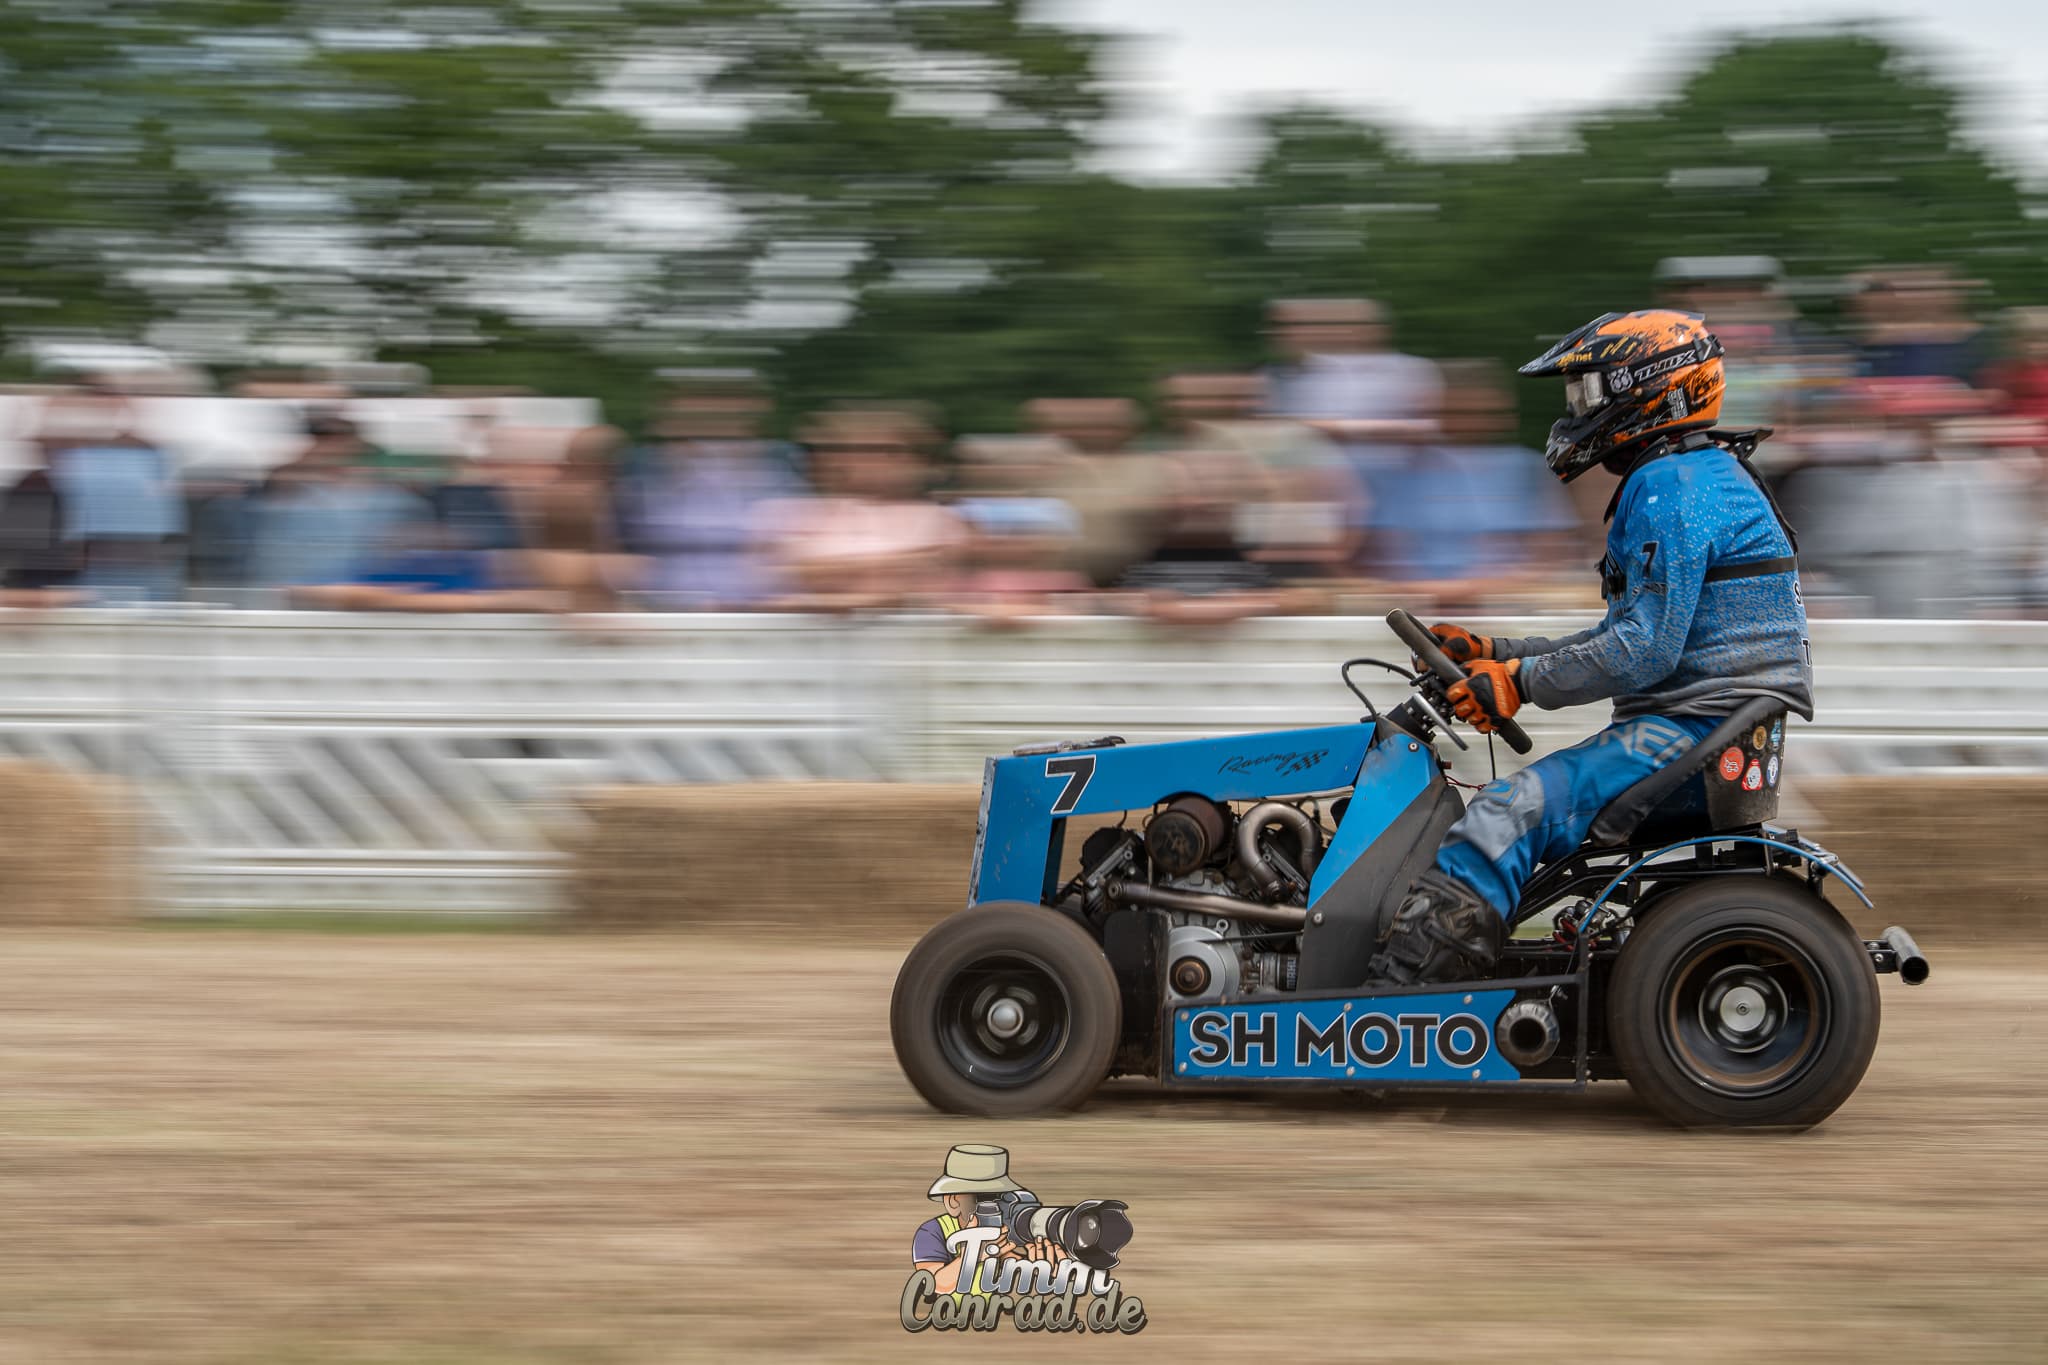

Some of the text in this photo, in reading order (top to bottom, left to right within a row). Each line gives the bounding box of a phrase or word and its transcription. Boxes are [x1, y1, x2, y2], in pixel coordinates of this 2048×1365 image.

[1640, 540, 1660, 579] 7
[1044, 753, 1097, 815] 7
[1217, 751, 1298, 775] Racing
[1189, 1011, 1490, 1068] SH MOTO
